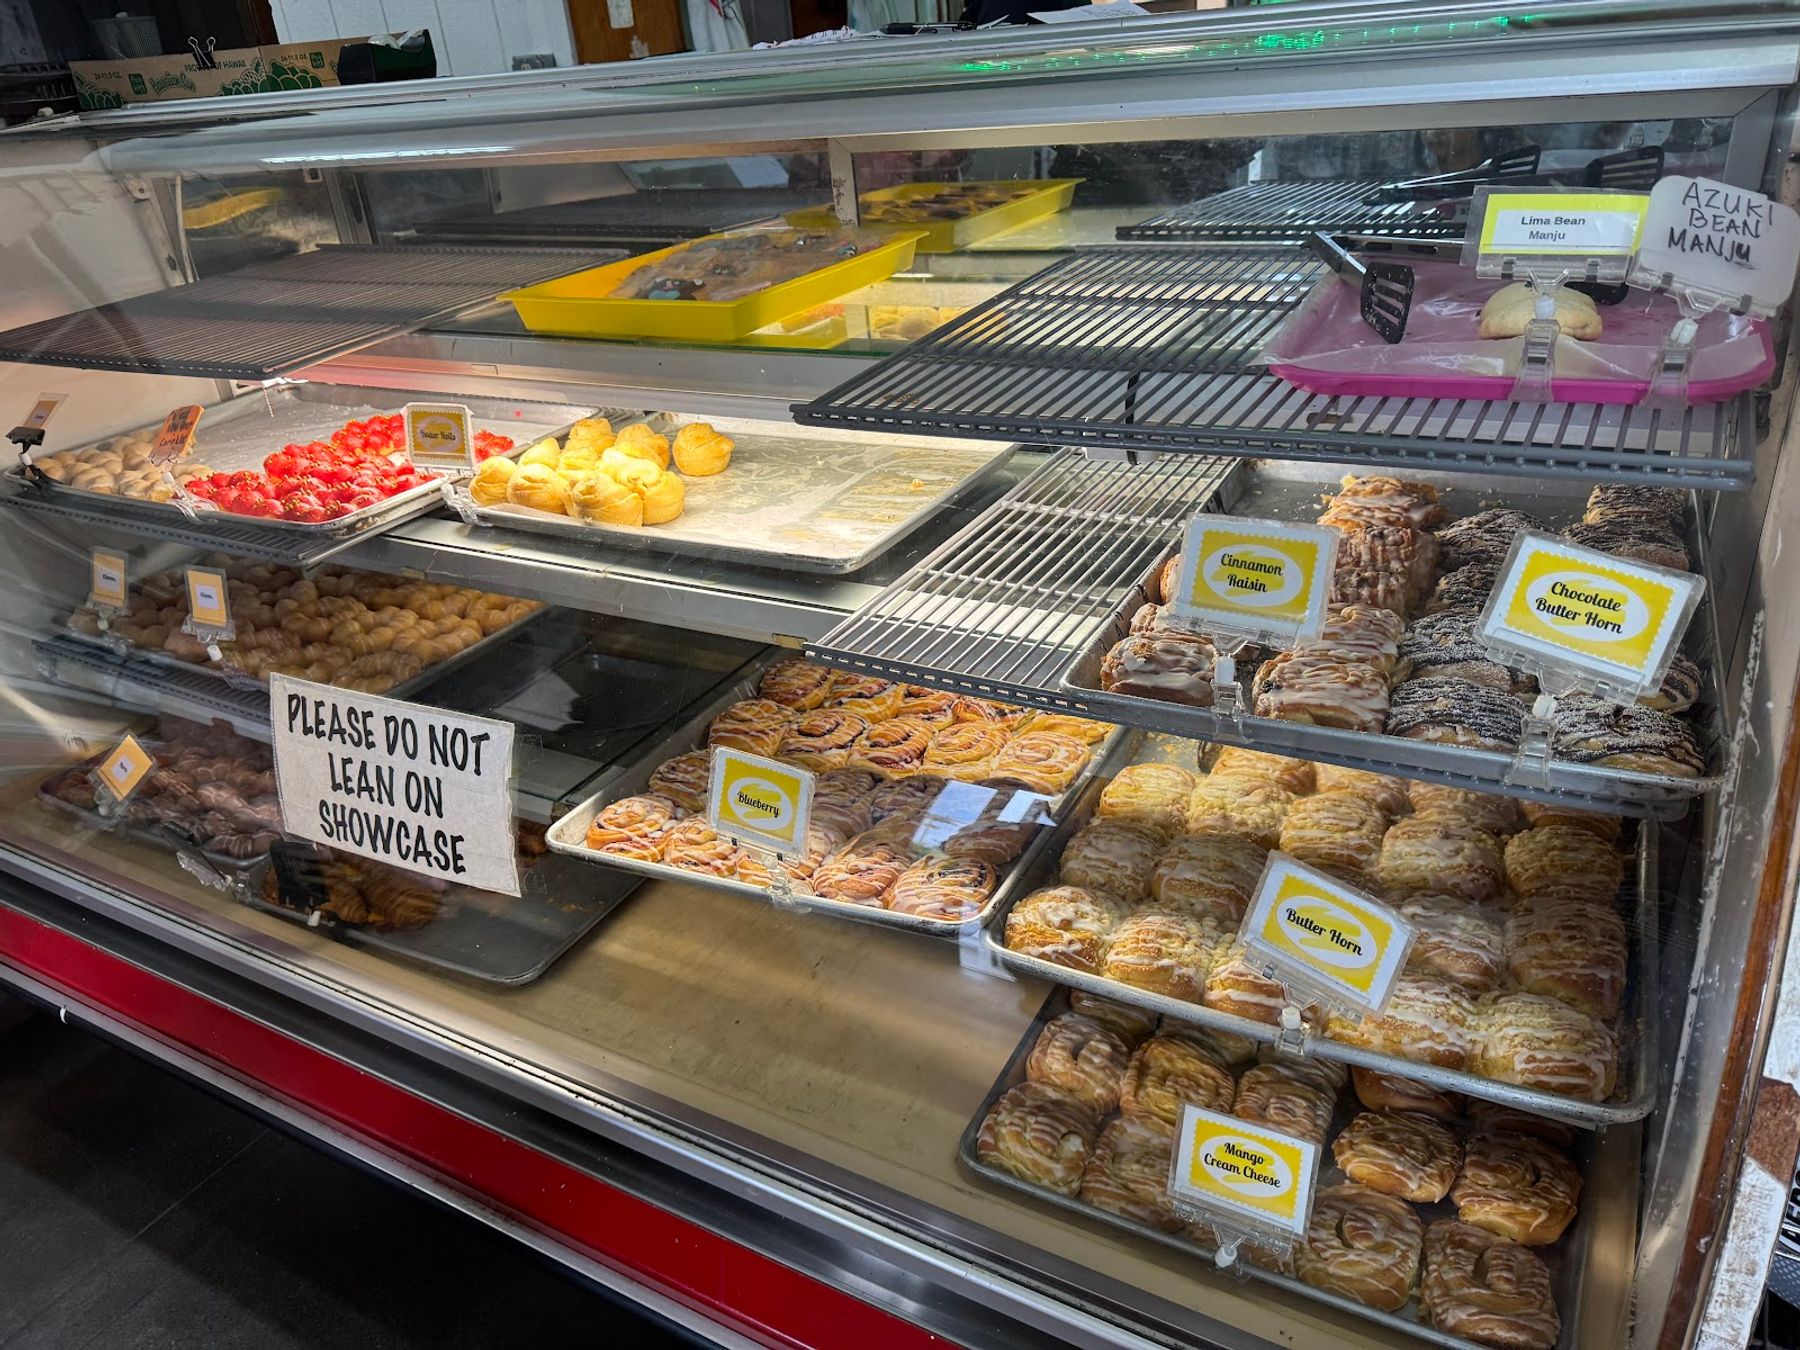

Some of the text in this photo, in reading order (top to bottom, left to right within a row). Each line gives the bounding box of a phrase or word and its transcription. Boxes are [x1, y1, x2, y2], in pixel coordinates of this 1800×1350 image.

[1682, 181, 1773, 226] AZUKI
[1521, 216, 1586, 225] Lima Bean
[1528, 230, 1566, 241] Manju
[1689, 208, 1760, 238] BEAN
[1668, 227, 1750, 262] MANJU
[1221, 553, 1283, 576] Cinnamon
[1227, 573, 1267, 593] Raisin
[1551, 581, 1622, 612] Chocolate
[1535, 597, 1622, 634] Butter Horn
[288, 694, 490, 776] PLEASE DO NOT
[328, 752, 443, 818] LEAN ON
[737, 791, 780, 818] Blueberry
[319, 799, 466, 874] SHOWCASE
[1286, 907, 1363, 956] Butter Horn
[1224, 1142, 1264, 1165] Mango
[1204, 1153, 1281, 1188] Cream Cheese
